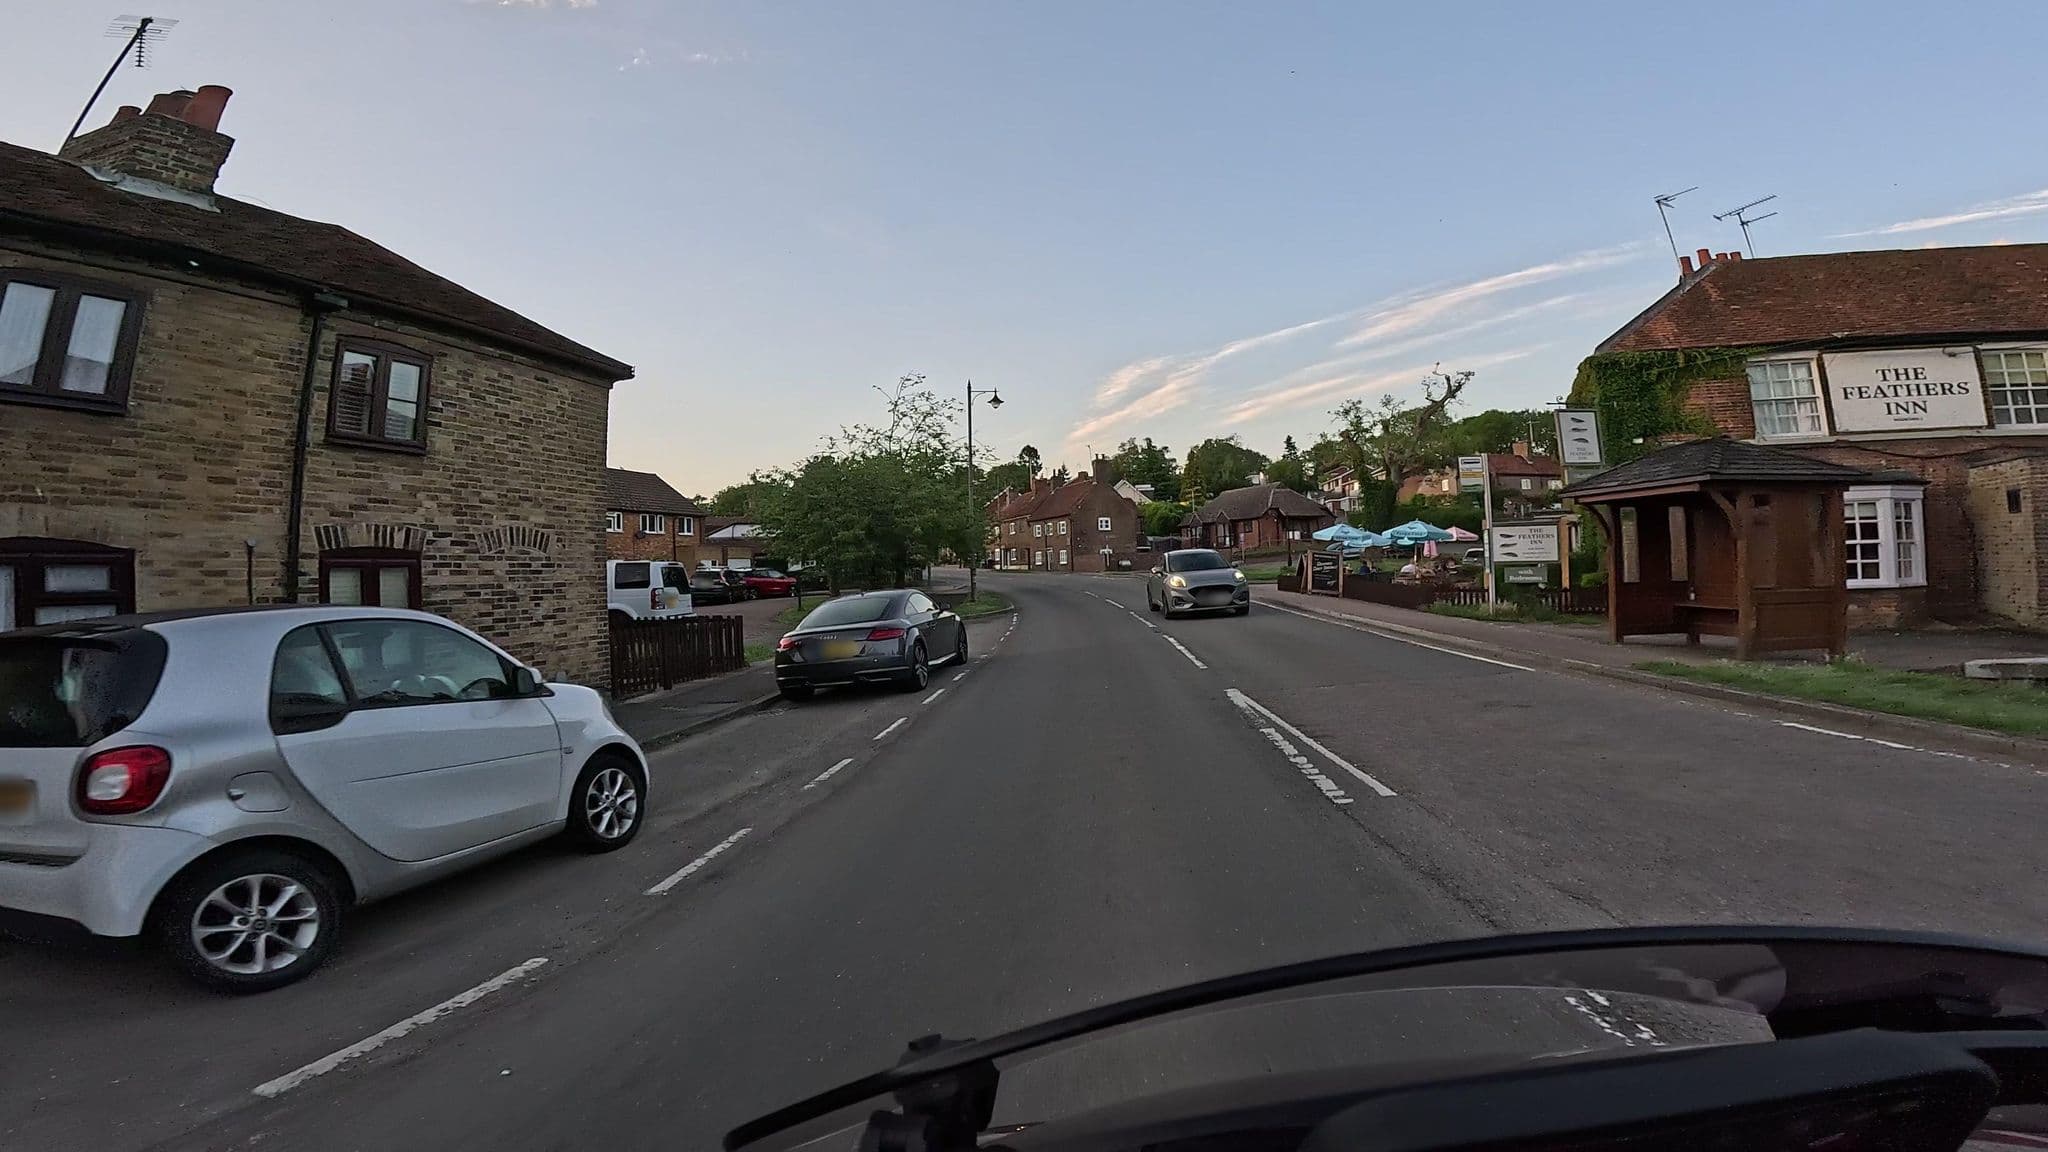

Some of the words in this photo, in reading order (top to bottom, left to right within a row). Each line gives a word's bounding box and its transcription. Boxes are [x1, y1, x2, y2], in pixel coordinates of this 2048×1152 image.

[1875, 367, 1927, 382] THE
[1842, 381, 1970, 401] FEATHERS
[1884, 400, 1928, 416] INN
